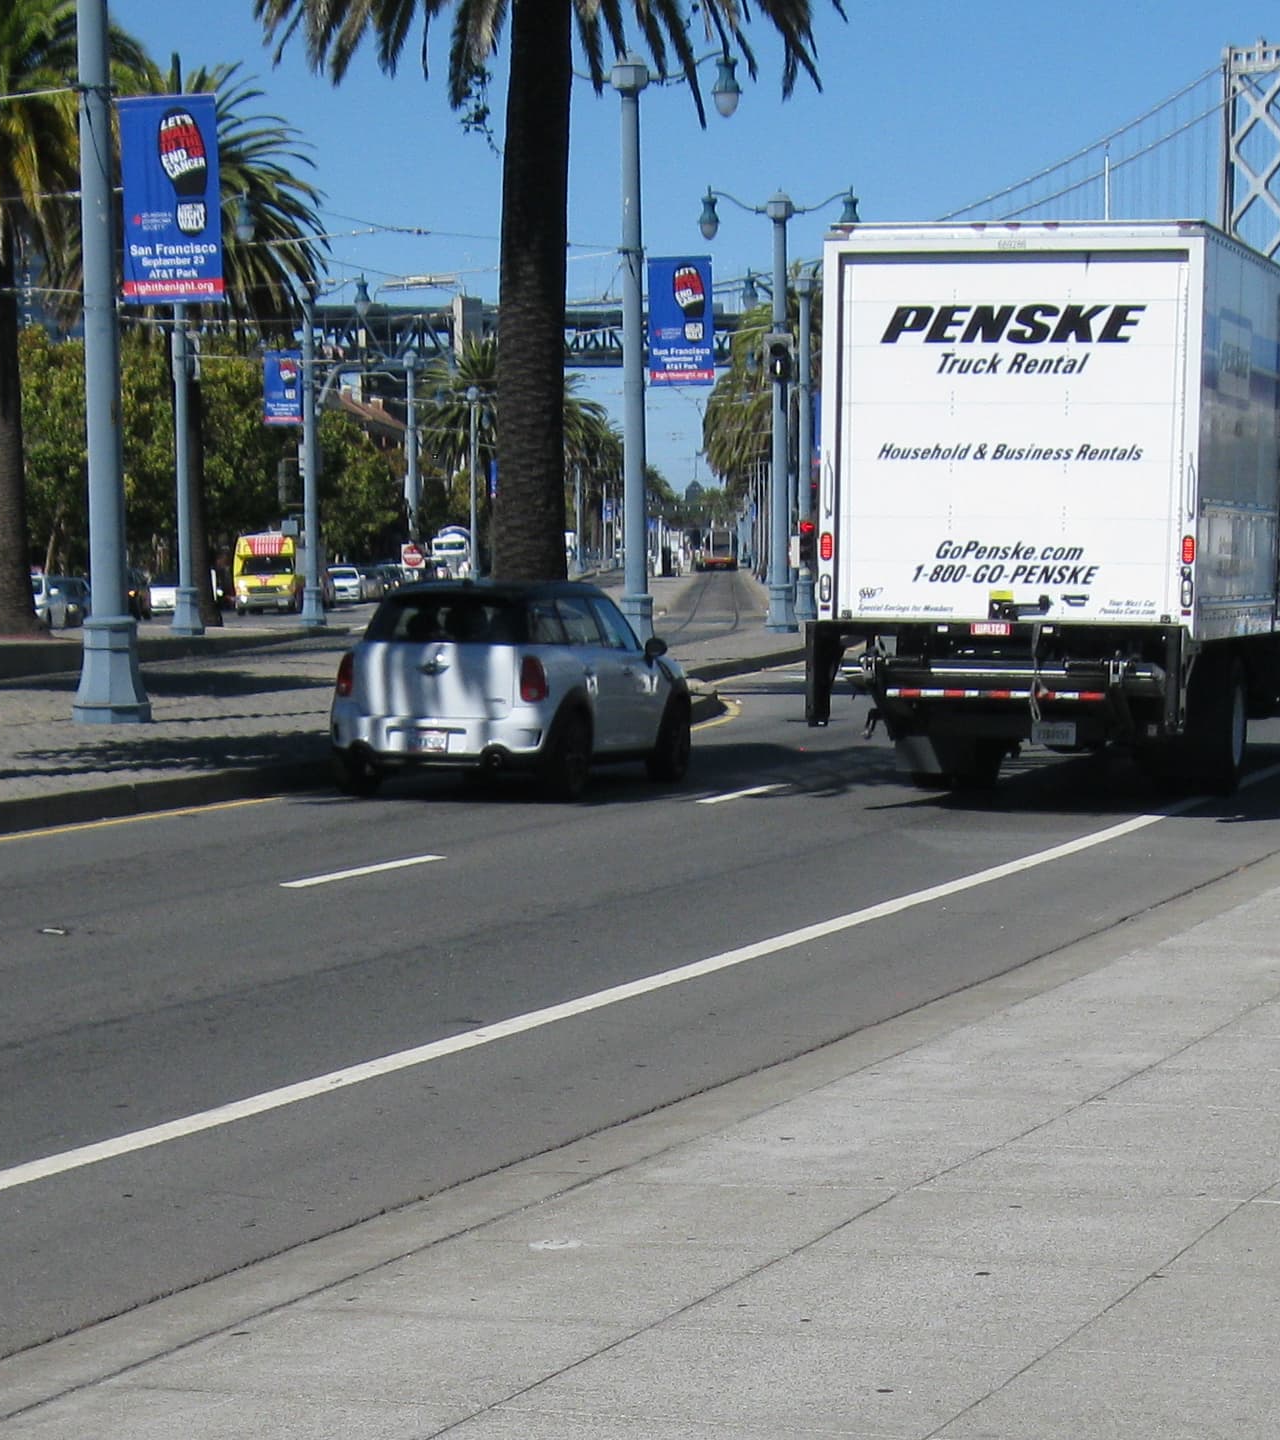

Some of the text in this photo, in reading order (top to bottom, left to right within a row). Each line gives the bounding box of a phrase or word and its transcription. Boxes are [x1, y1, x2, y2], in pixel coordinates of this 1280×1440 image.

[160, 114, 193, 131] LET'S
[161, 148, 188, 167] END
[166, 157, 207, 179] CANCER
[177, 208, 205, 221] NIGHT
[179, 218, 205, 231] WALK
[130, 242, 217, 257] San Francisco
[141, 256, 191, 268] September
[149, 268, 199, 279] AT&T Park
[880, 303, 1148, 344] PENSKE
[936, 352, 1091, 375] Truck Rental
[877, 442, 1143, 461] Household & Business Rentals
[935, 539, 1084, 561] GoPenske.com
[911, 564, 1100, 586] 1-800-GO-PENSKE
